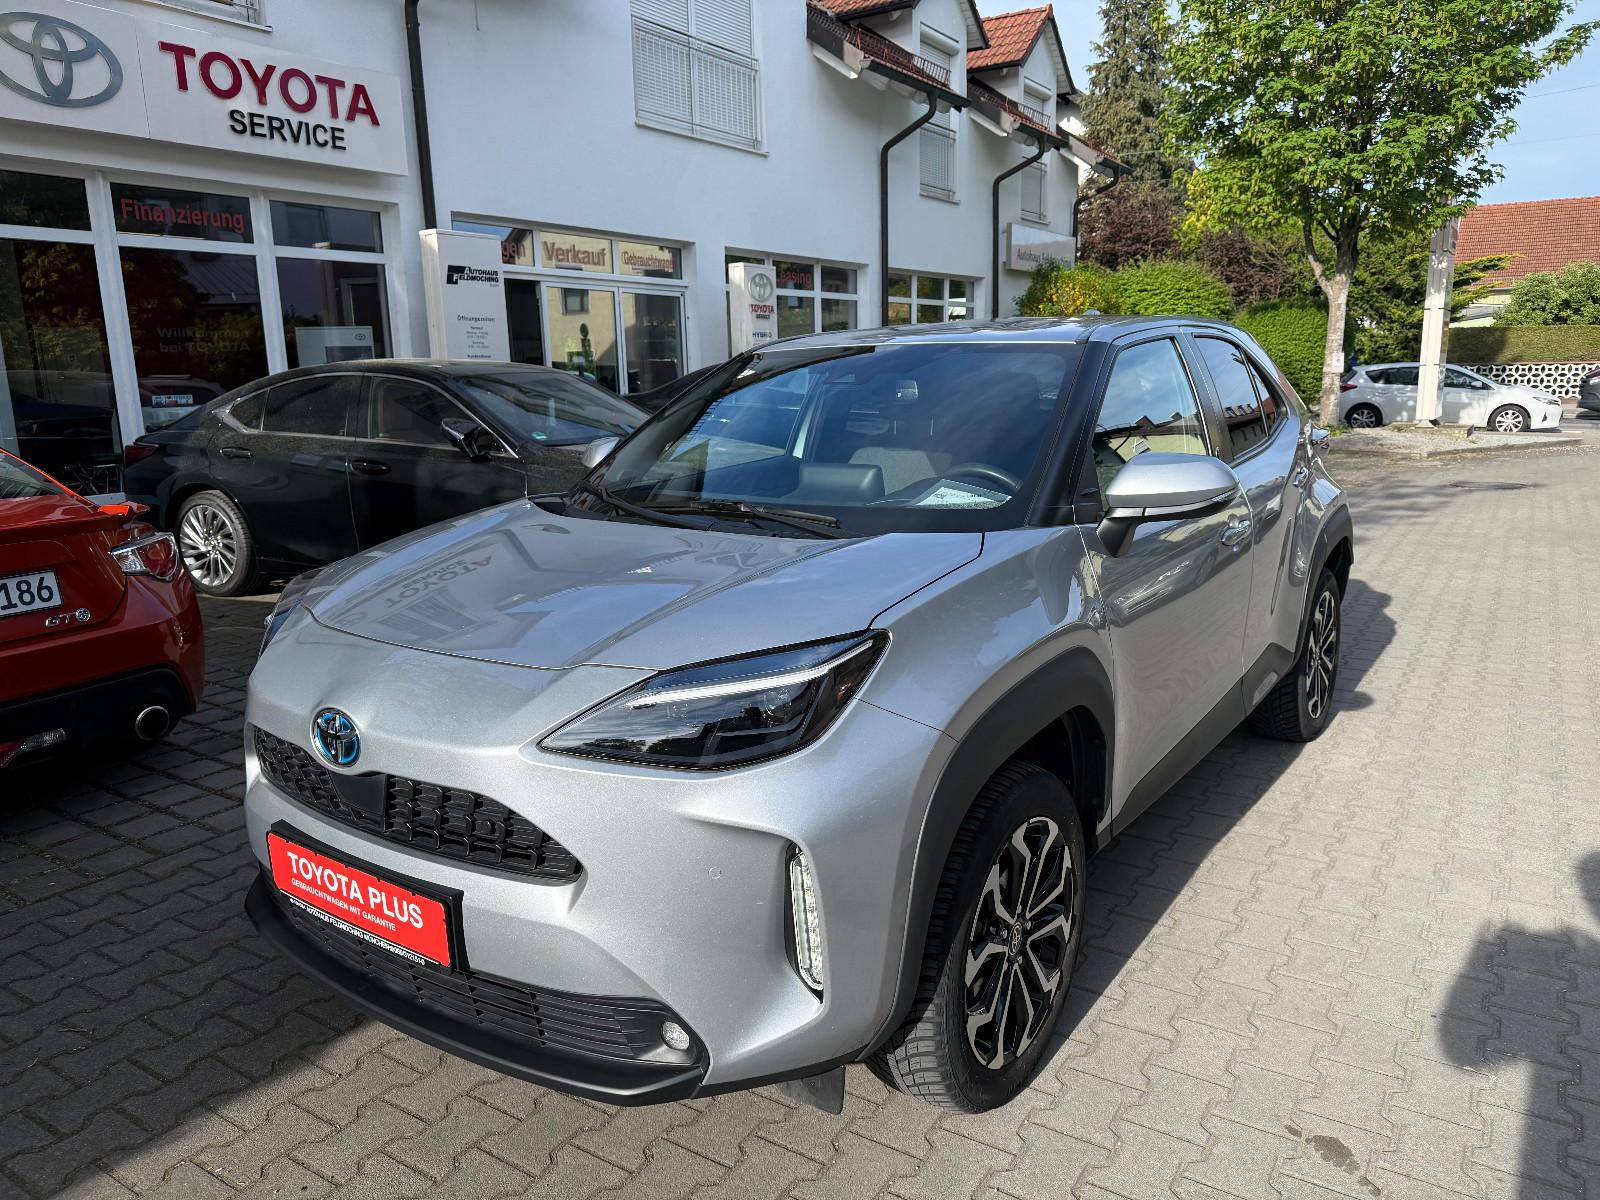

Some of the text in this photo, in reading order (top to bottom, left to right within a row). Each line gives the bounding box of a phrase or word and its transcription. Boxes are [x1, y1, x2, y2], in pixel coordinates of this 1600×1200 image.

[158, 40, 380, 126] TOYOTA
[228, 109, 347, 151] SERVICE
[120, 197, 245, 234] Finanzierung
[501, 240, 526, 260] gen
[543, 240, 607, 267] Verkauf
[453, 274, 499, 283] FELDMOCHING
[463, 266, 499, 276] AUTOHAUS
[750, 303, 775, 314] TOYOTA
[160, 341, 251, 354] bei TOYOTA
[0, 576, 54, 610] 186
[286, 850, 424, 929] TOYOTA PLUS
[291, 877, 349, 910] GEBRAUCHTWAGEN
[349, 904, 361, 916] MIT
[362, 910, 397, 932] GARANTIE
